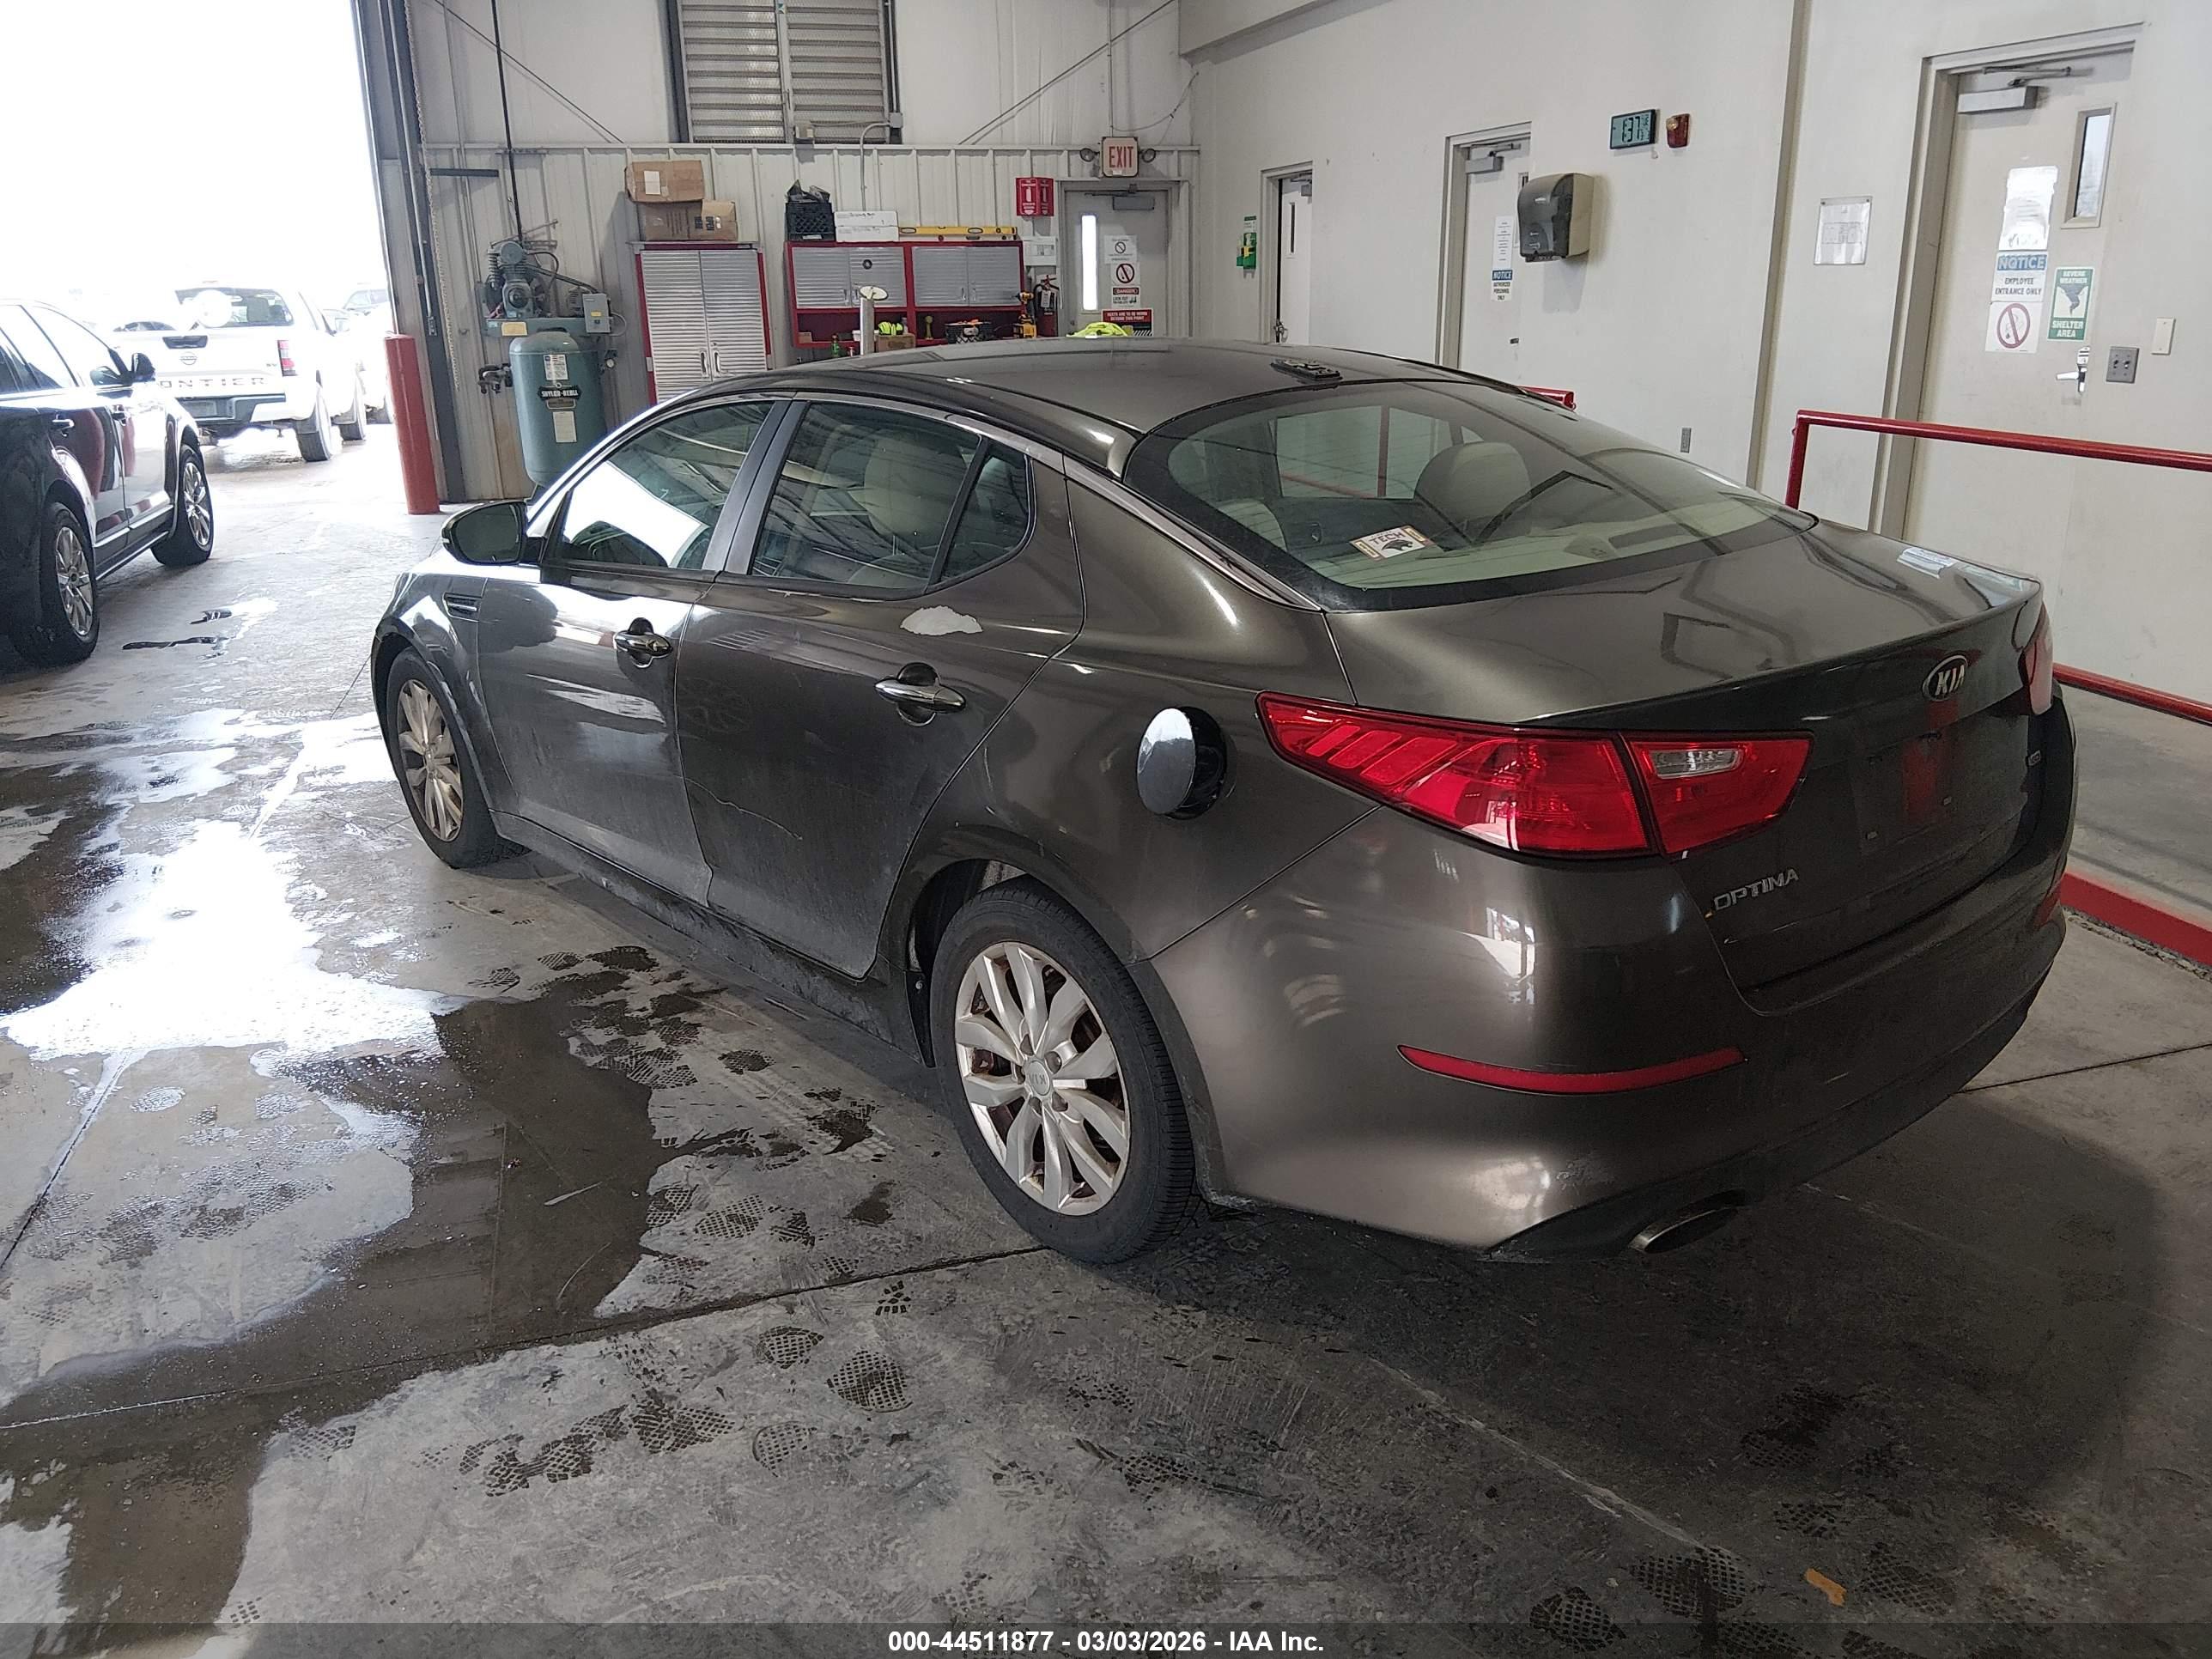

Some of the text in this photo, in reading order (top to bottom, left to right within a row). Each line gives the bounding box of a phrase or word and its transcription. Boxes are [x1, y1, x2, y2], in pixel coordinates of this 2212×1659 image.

[1109, 146, 1134, 168] EXIT
[1998, 256, 2046, 270] NOTICE
[1492, 270, 1512, 279] NOTICE
[2051, 320, 2084, 329] SHELTER
[2057, 329, 2076, 337] AREA
[160, 377, 264, 388] ONTIER
[1370, 532, 1406, 544] TECH
[1935, 665, 1965, 696] KIA
[1713, 868, 1799, 911] OPTIMA
